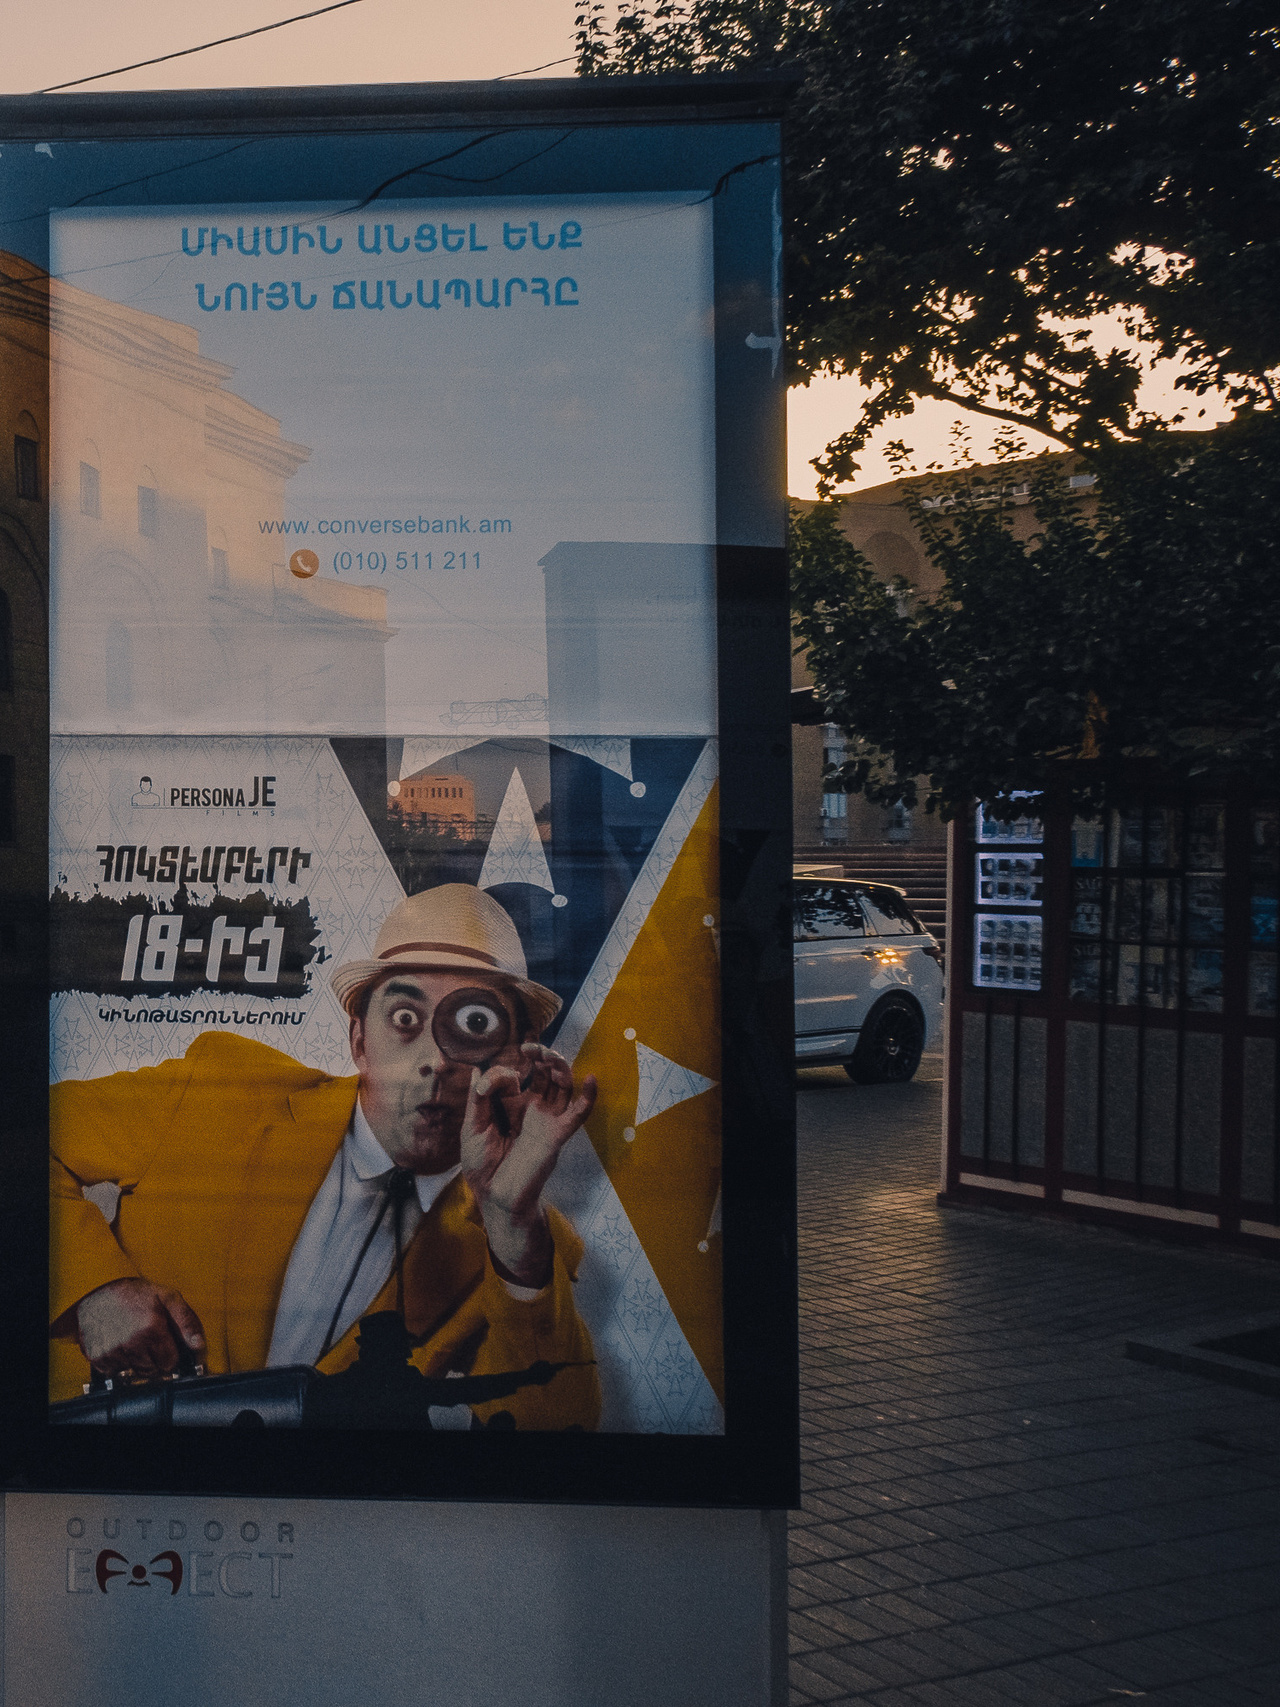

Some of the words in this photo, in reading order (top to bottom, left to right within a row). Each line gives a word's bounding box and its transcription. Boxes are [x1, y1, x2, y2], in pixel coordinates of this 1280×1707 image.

[181, 225, 343, 257] ՄԻԱՍԻՆ
[357, 222, 488, 255] ԱՆՑԵԼ
[503, 220, 583, 250] ԵՆՔ
[195, 281, 317, 312] ՆՈՒՅՆ
[332, 276, 579, 311] ՃԱՆԱՊԱՐՀԸ
[258, 515, 512, 534] www.conversebank.am
[332, 551, 388, 573] (010)
[395, 552, 434, 571] 511
[443, 551, 482, 570] 211
[205, 809, 276, 817] FILMS
[66, 1516, 295, 1543] OUTDOOR
